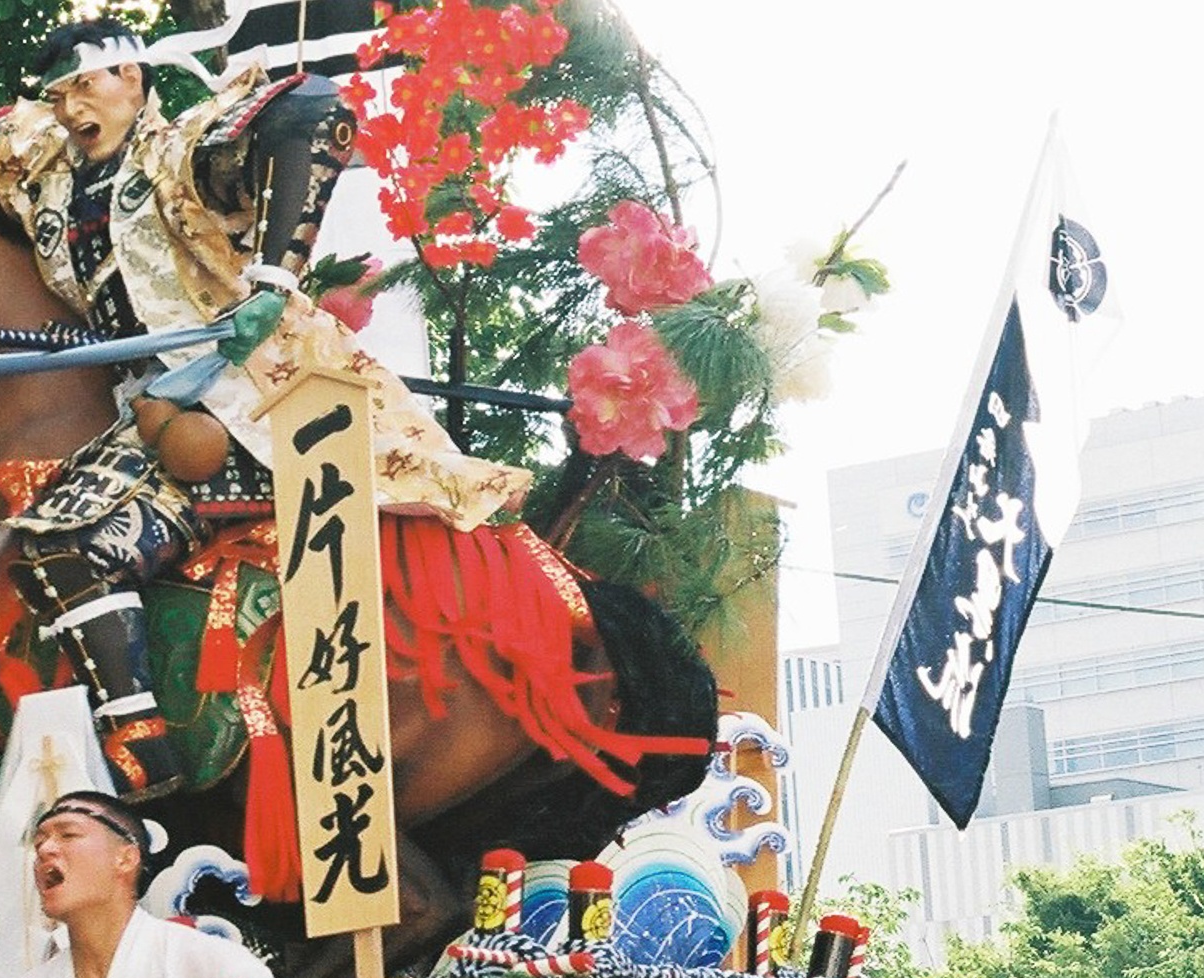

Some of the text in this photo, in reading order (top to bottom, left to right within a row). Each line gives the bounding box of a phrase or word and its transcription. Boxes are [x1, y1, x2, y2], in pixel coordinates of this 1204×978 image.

[284, 403, 390, 904] 一片好風光
